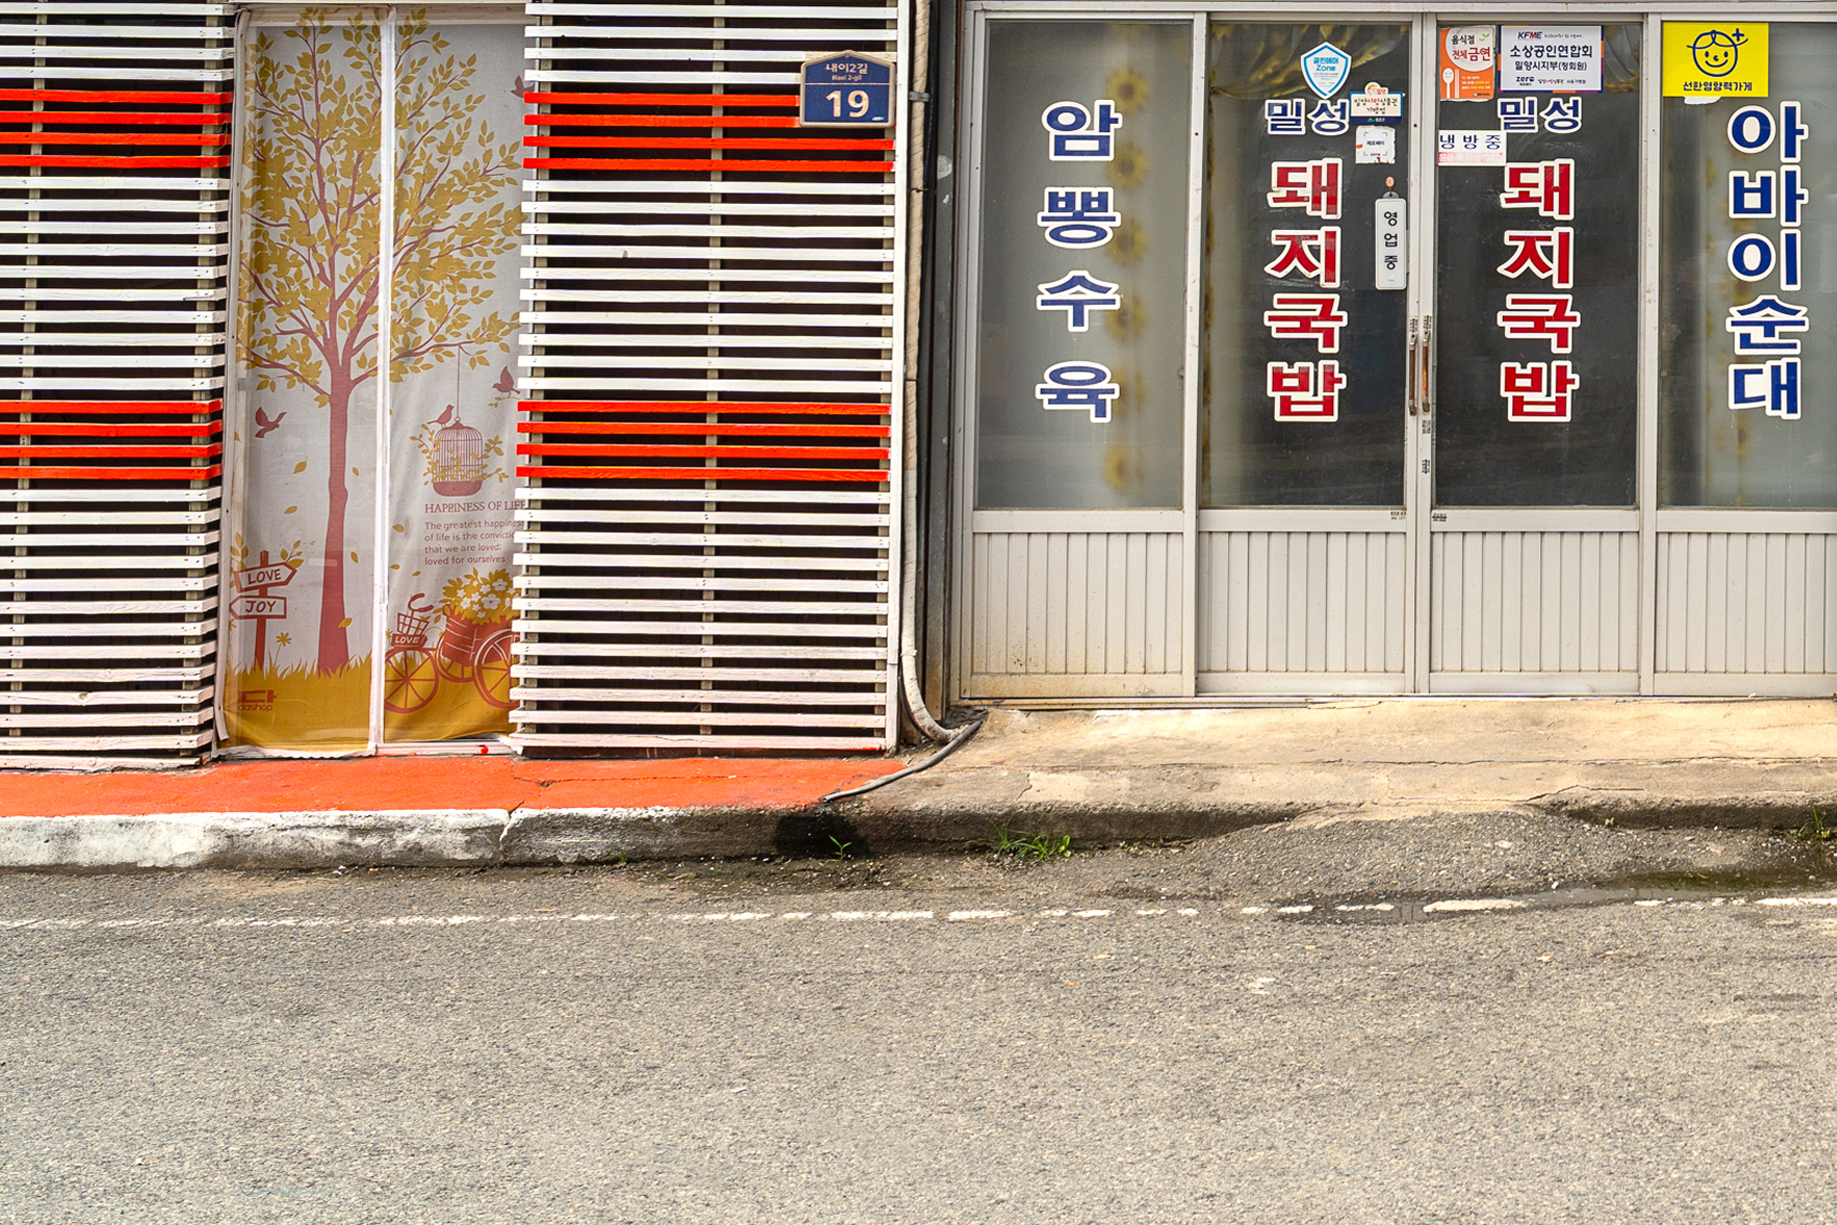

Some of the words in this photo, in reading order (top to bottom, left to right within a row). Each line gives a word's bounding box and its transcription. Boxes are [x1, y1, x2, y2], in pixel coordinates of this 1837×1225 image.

[1451, 34, 1475, 45] 음식점
[1517, 31, 1543, 39] KFME
[1452, 49, 1467, 59] 전체
[1468, 47, 1491, 61] 금연
[1510, 45, 1592, 58] 소상공인연합회
[826, 63, 868, 74] 내이2길
[1514, 60, 1587, 72] 밀양시지부(정회원)
[826, 90, 869, 118] 19
[1265, 99, 1350, 136] 밀성
[1497, 97, 1582, 134] 밀성
[1384, 211, 1398, 271] 영업중
[1036, 99, 1123, 423] 암뽕수육
[1725, 101, 1810, 420] 아바이순대
[1264, 158, 1347, 422] 돼지국밥
[1497, 158, 1581, 422] 돼지국밥
[425, 502, 486, 513] HAPPINESS
[488, 501, 502, 511] OF
[504, 500, 525, 511] LIFE
[425, 522, 441, 530] The
[443, 521, 482, 531] greatest
[484, 519, 525, 529] happiness
[425, 533, 434, 542] of
[436, 532, 450, 542] life
[452, 532, 460, 541] is
[462, 531, 478, 540] the
[425, 544, 442, 554] that
[461, 544, 475, 552] are
[425, 556, 448, 566] loved
[451, 556, 465, 564] for
[247, 568, 282, 585] LOVE
[245, 600, 277, 614] JOY
[395, 636, 420, 644] LOVE
